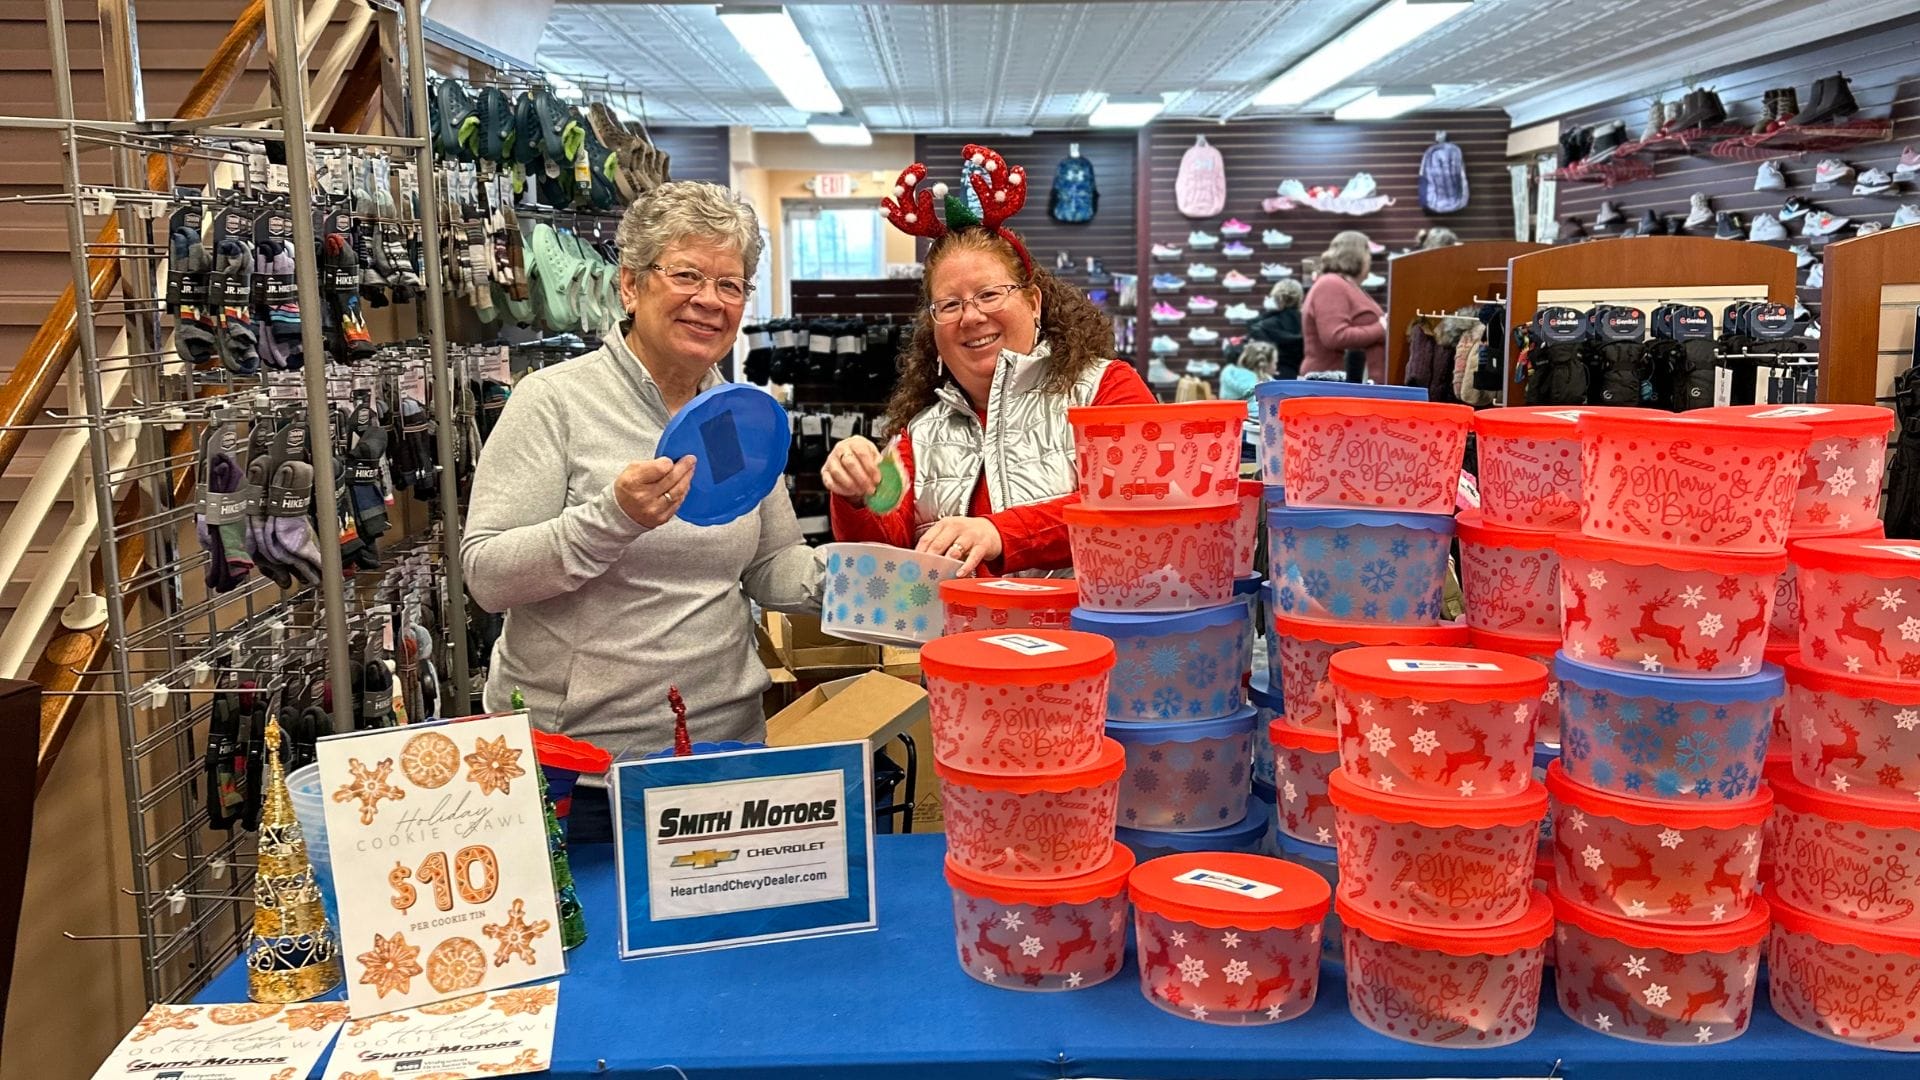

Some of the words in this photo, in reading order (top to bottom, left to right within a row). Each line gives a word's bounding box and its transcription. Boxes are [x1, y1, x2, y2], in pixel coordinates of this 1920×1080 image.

[821, 176, 845, 194] EXIT
[1346, 438, 1419, 473] Merry
[1427, 441, 1444, 467] &
[1360, 462, 1433, 497] Bright
[1486, 457, 1541, 492] Merry
[1553, 460, 1577, 486] &
[1631, 464, 1717, 506] Merry
[1729, 469, 1754, 499] &
[1494, 480, 1564, 516] Bright
[1645, 491, 1737, 533] Bright
[1078, 548, 1126, 576] Merry
[1135, 545, 1157, 569] &
[1500, 566, 1521, 592] &
[1085, 566, 1145, 599] Bright
[1003, 706, 1074, 736] Merry
[1082, 698, 1096, 723] &
[1019, 721, 1087, 758] Bright
[395, 790, 494, 838] Holiday
[658, 808, 733, 838] SMITH
[740, 799, 837, 829] MOTORS
[981, 808, 1003, 834] &
[1023, 812, 1090, 842] Merry
[1097, 801, 1110, 826] &
[356, 828, 440, 852] COOKIE
[454, 814, 526, 836] CRAWL
[747, 841, 825, 858] CHEVROLET
[1038, 826, 1105, 861] Bright
[388, 844, 499, 916] $10
[1415, 852, 1496, 885] Merry
[1505, 848, 1522, 875] &
[1795, 838, 1871, 885] Merry
[1885, 855, 1913, 883] &
[670, 871, 828, 897] HeartlandChevyDealer.com
[1433, 872, 1514, 910] Bright
[1807, 866, 1895, 912] Bright
[410, 921, 429, 932] PER
[431, 914, 468, 928] COOKIE
[470, 910, 487, 921] TIN
[1359, 956, 1427, 1004] Merry
[1440, 973, 1465, 1000] &
[1787, 954, 1862, 1004] Merry
[1876, 974, 1904, 1001] &
[1370, 984, 1450, 1029] Bright
[1800, 984, 1887, 1029] Bright
[202, 1057, 289, 1066] MOTORS
[437, 1039, 523, 1054] MOTORS
